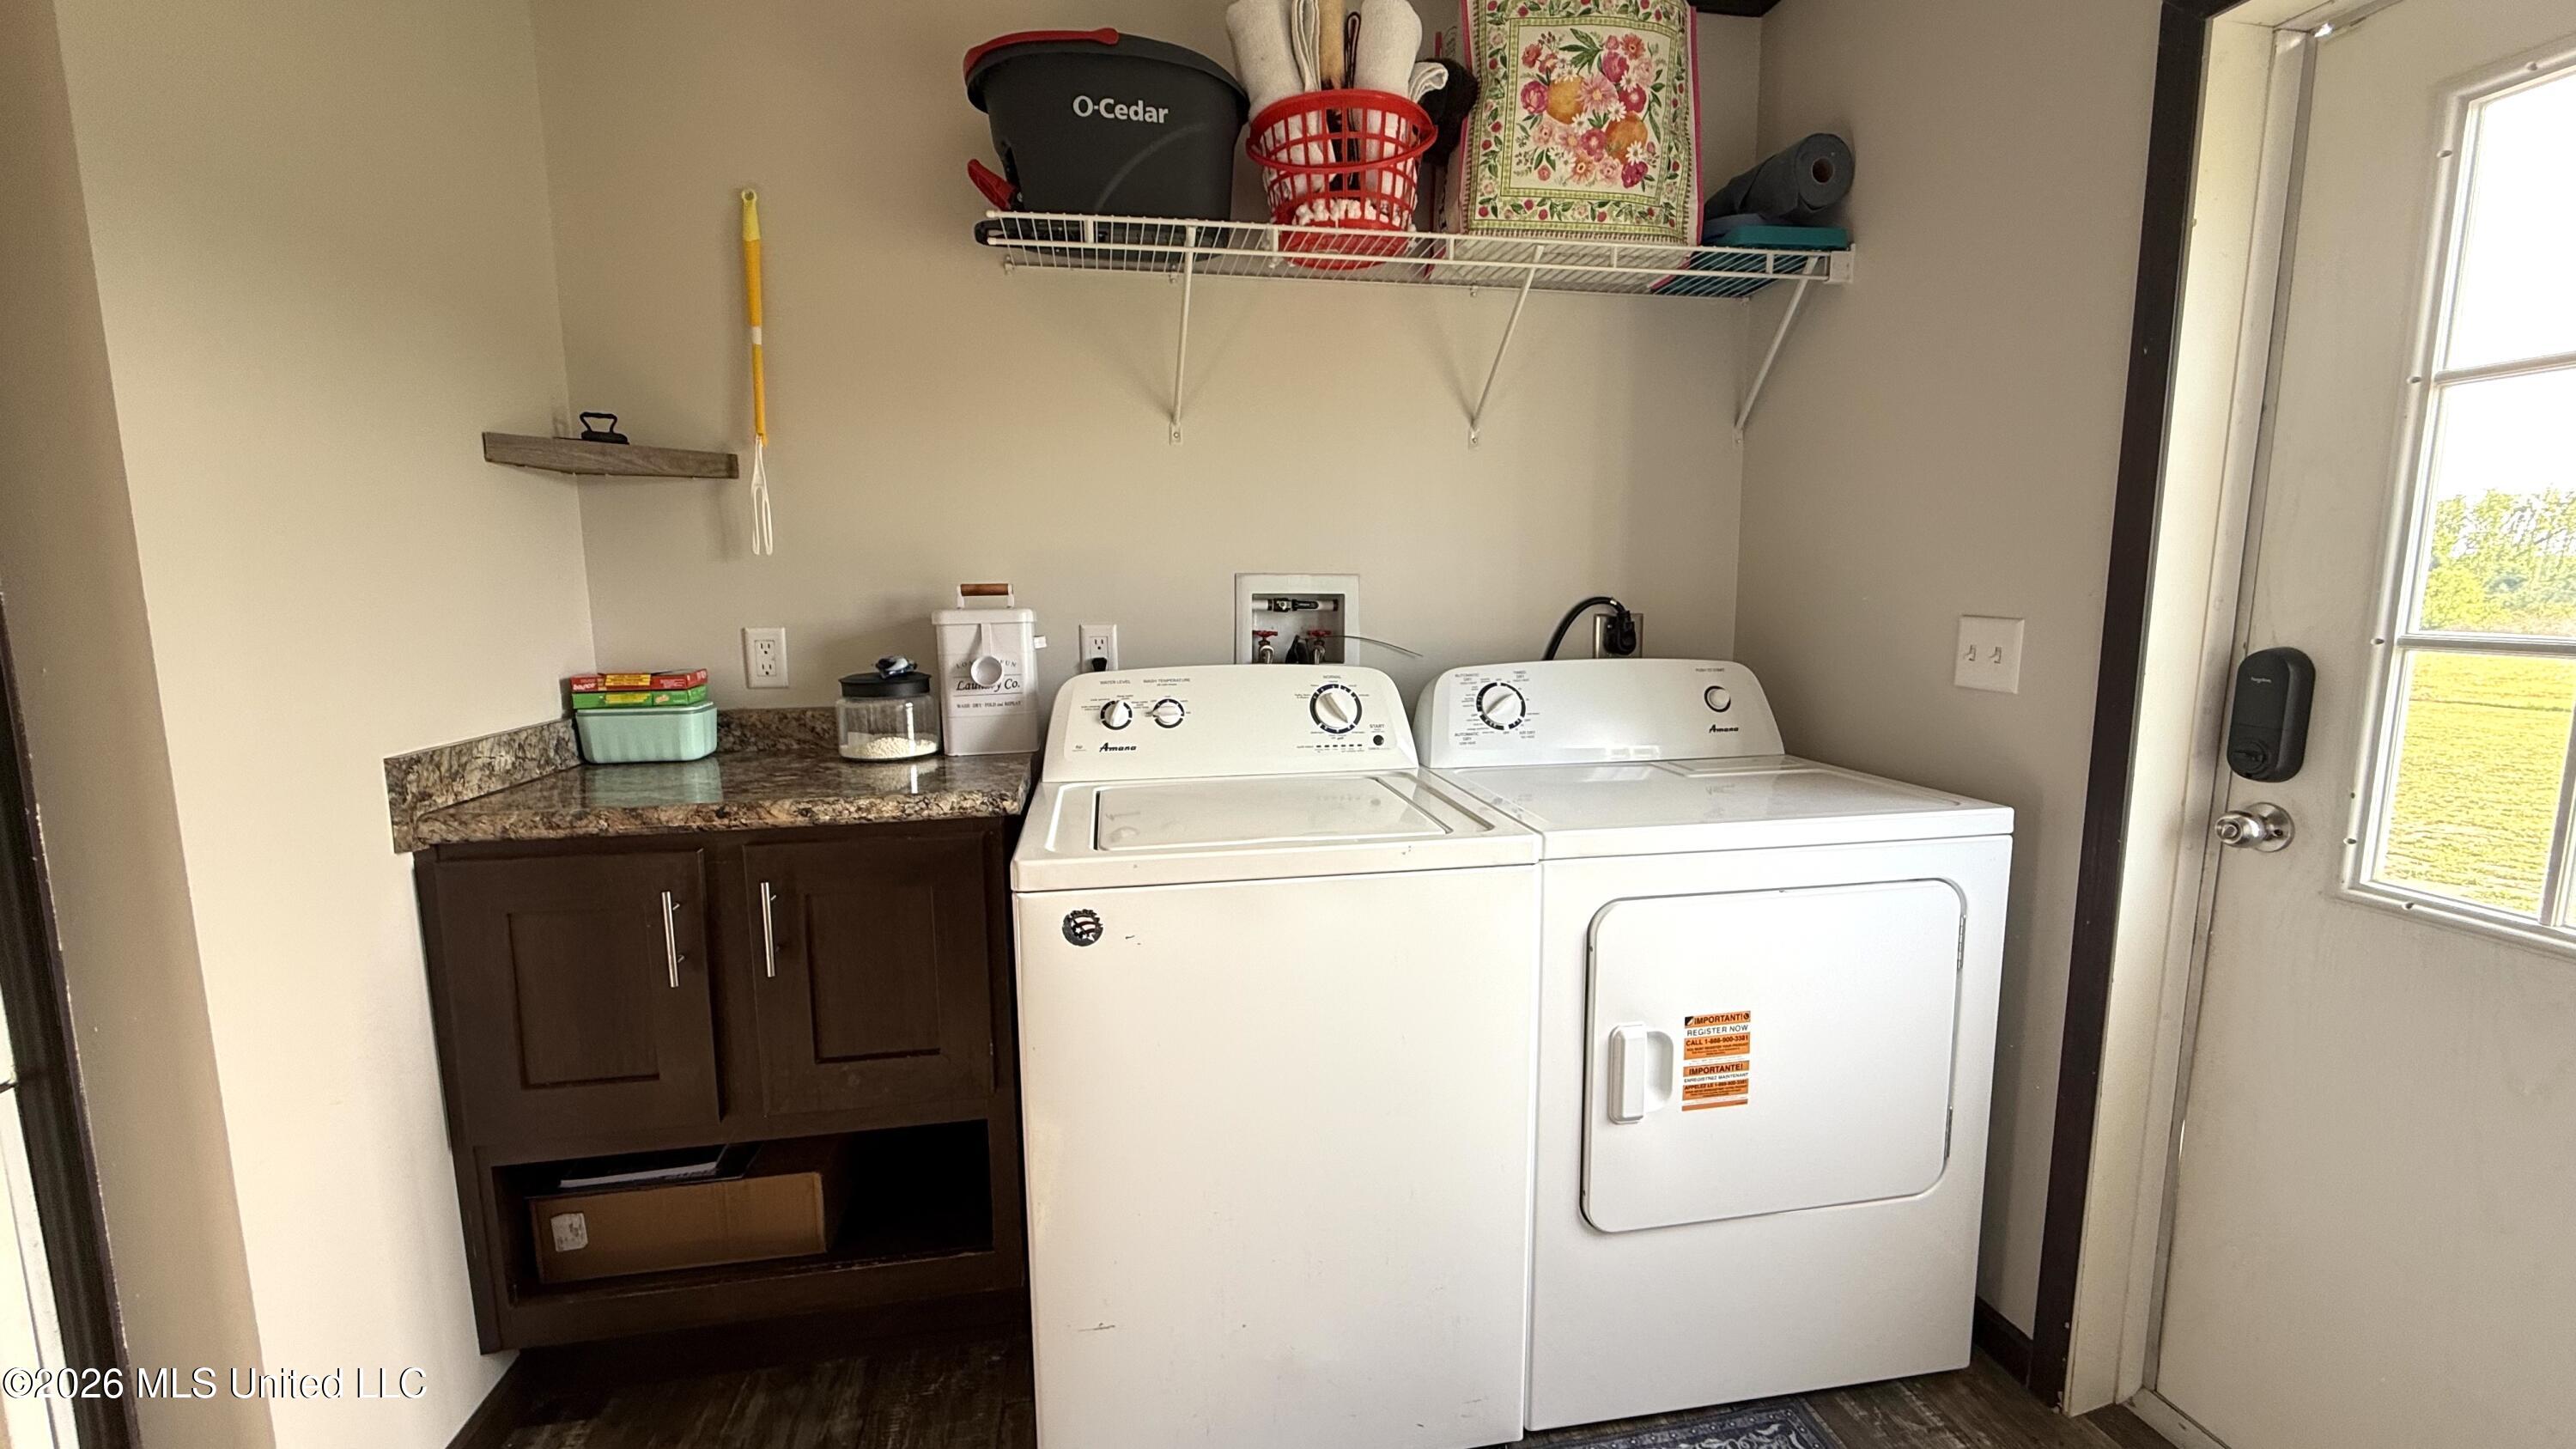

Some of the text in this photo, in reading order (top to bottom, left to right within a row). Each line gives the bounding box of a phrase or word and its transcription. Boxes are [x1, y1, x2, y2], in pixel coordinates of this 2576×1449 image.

[1072, 95, 1169, 124] O-Cedar
[1004, 678, 1020, 690] Co.
[1709, 724, 1739, 734] Amana
[1099, 742, 1137, 752] Amana
[1694, 1014, 1743, 1025] IMPORTANT!
[1686, 1026, 1727, 1037] REGISTER
[1689, 1063, 1743, 1075] IMPORTANTE!
